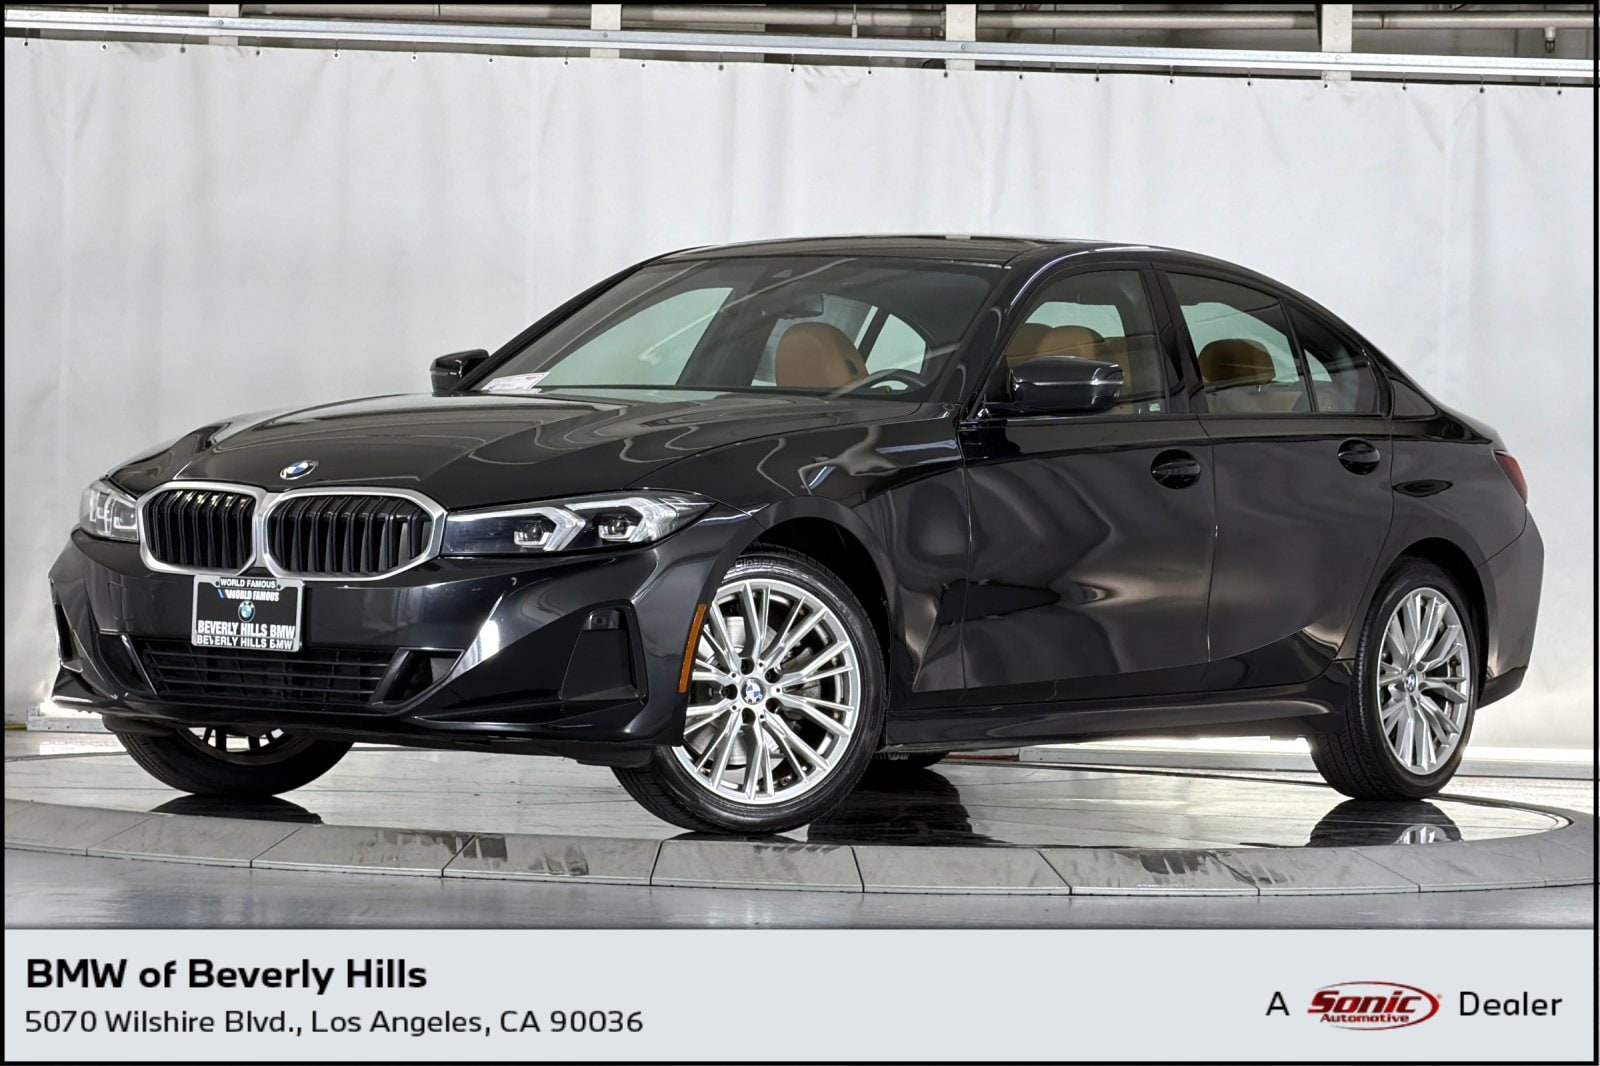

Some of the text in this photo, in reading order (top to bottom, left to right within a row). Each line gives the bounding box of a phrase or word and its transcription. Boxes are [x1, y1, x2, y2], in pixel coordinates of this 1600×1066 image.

[220, 578, 276, 588] WORLD FAMOUS
[226, 590, 279, 602] WORLD FAMOUS
[198, 620, 295, 639] BEVERLY HILLS BMW
[240, 637, 267, 648] HILLS
